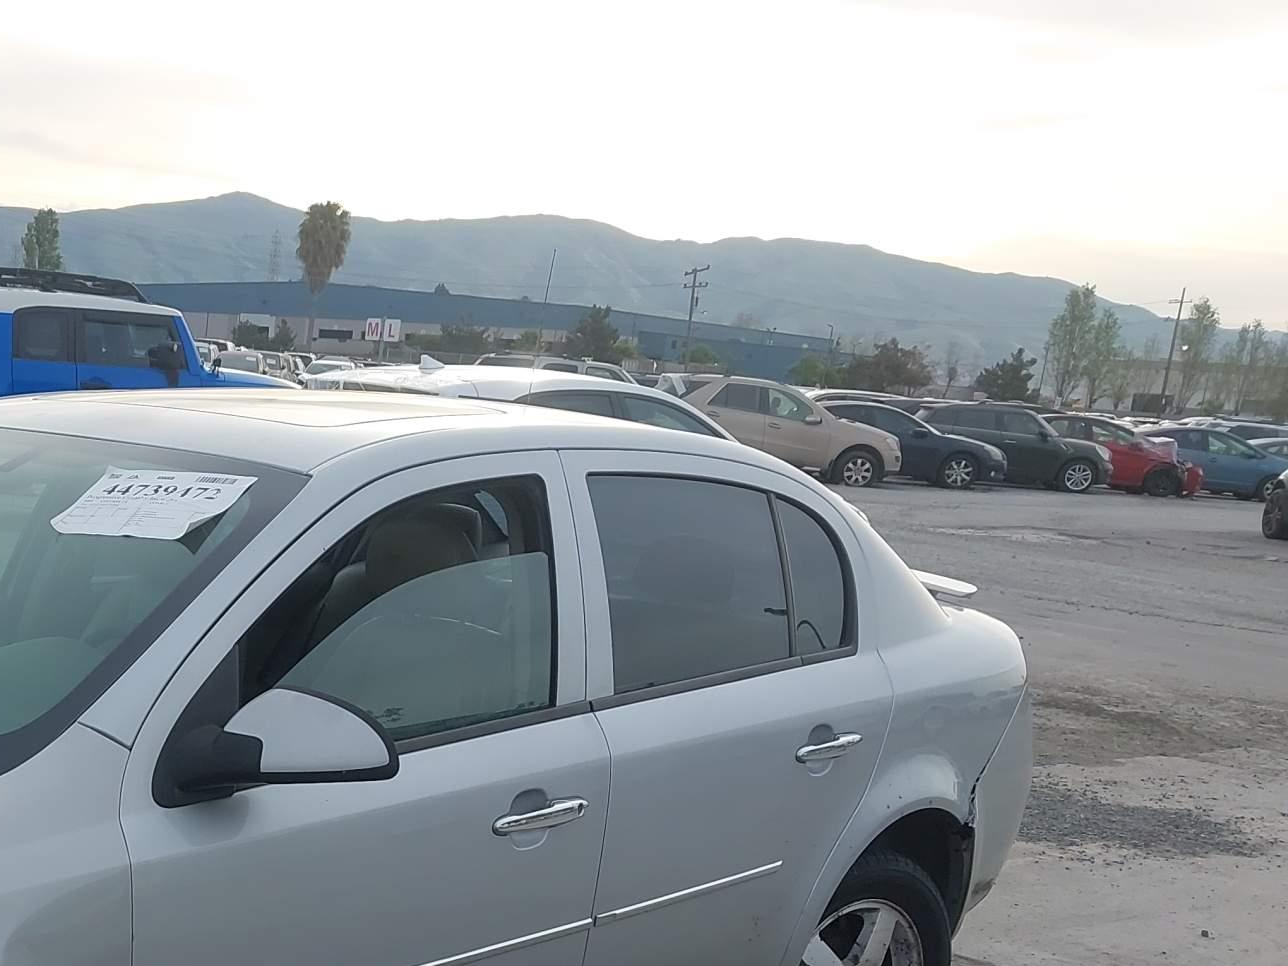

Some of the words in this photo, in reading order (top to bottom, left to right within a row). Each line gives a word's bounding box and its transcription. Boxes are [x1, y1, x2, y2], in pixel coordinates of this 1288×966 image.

[367, 322, 379, 337] M
[387, 323, 396, 338] L
[102, 483, 223, 500] 44739472
